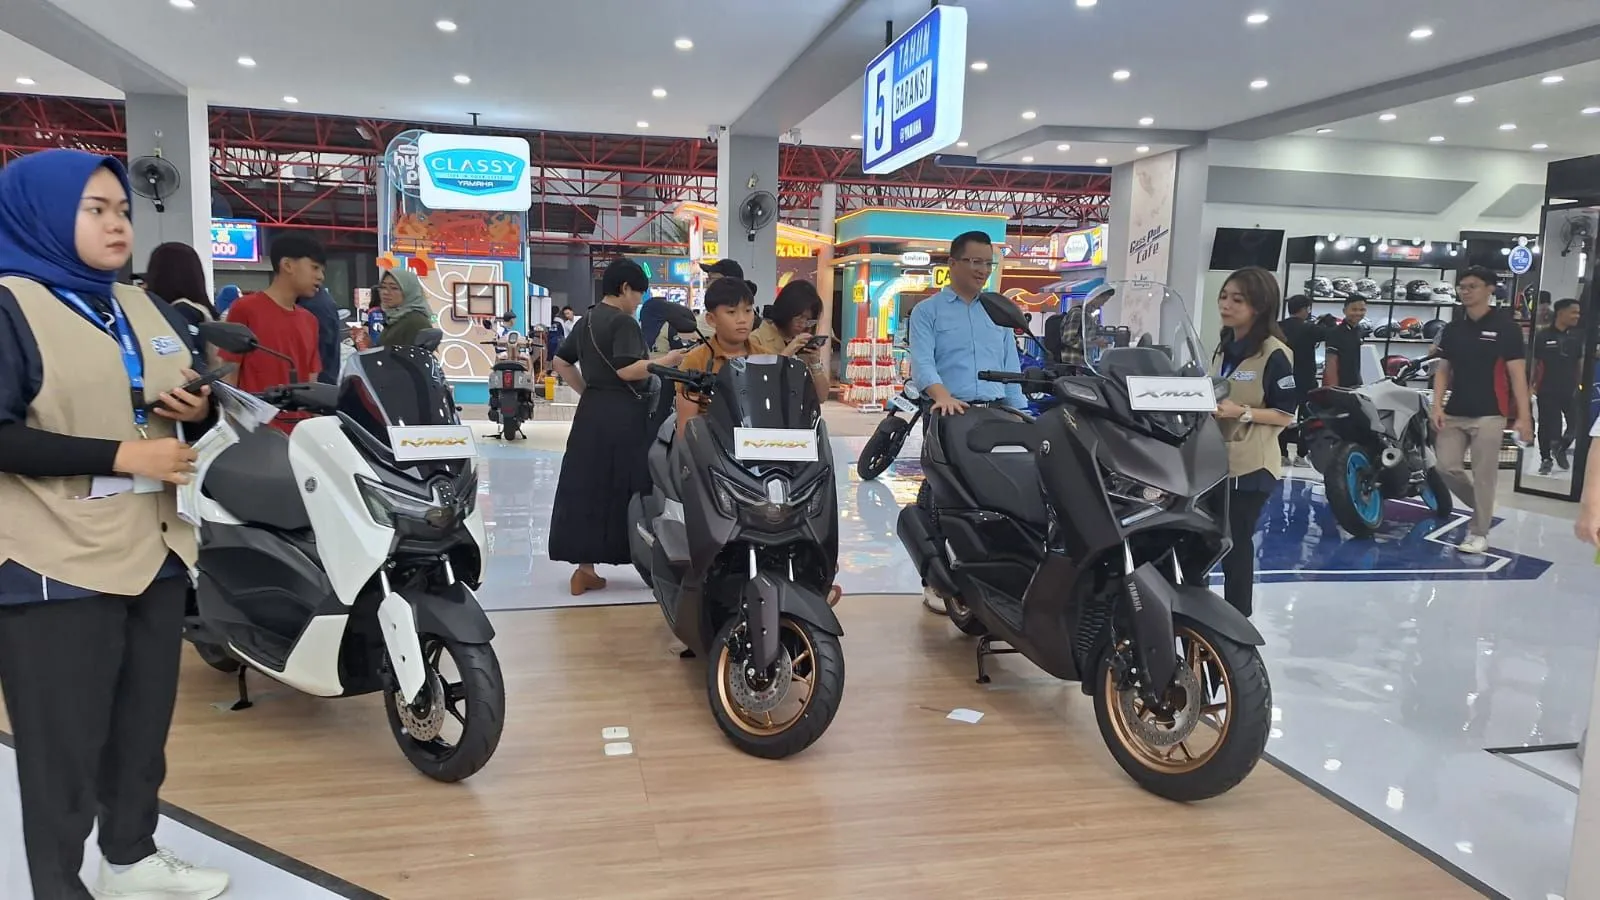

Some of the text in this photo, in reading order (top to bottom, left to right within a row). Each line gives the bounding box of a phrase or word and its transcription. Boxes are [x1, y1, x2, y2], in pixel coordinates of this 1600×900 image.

[899, 21, 930, 75] TAHUN
[874, 67, 886, 150] 5
[895, 66, 928, 114] GARANSI
[431, 157, 518, 173] CLASSY
[457, 180, 494, 188] YAMAHA
[1126, 581, 1143, 612] YAMAHA
